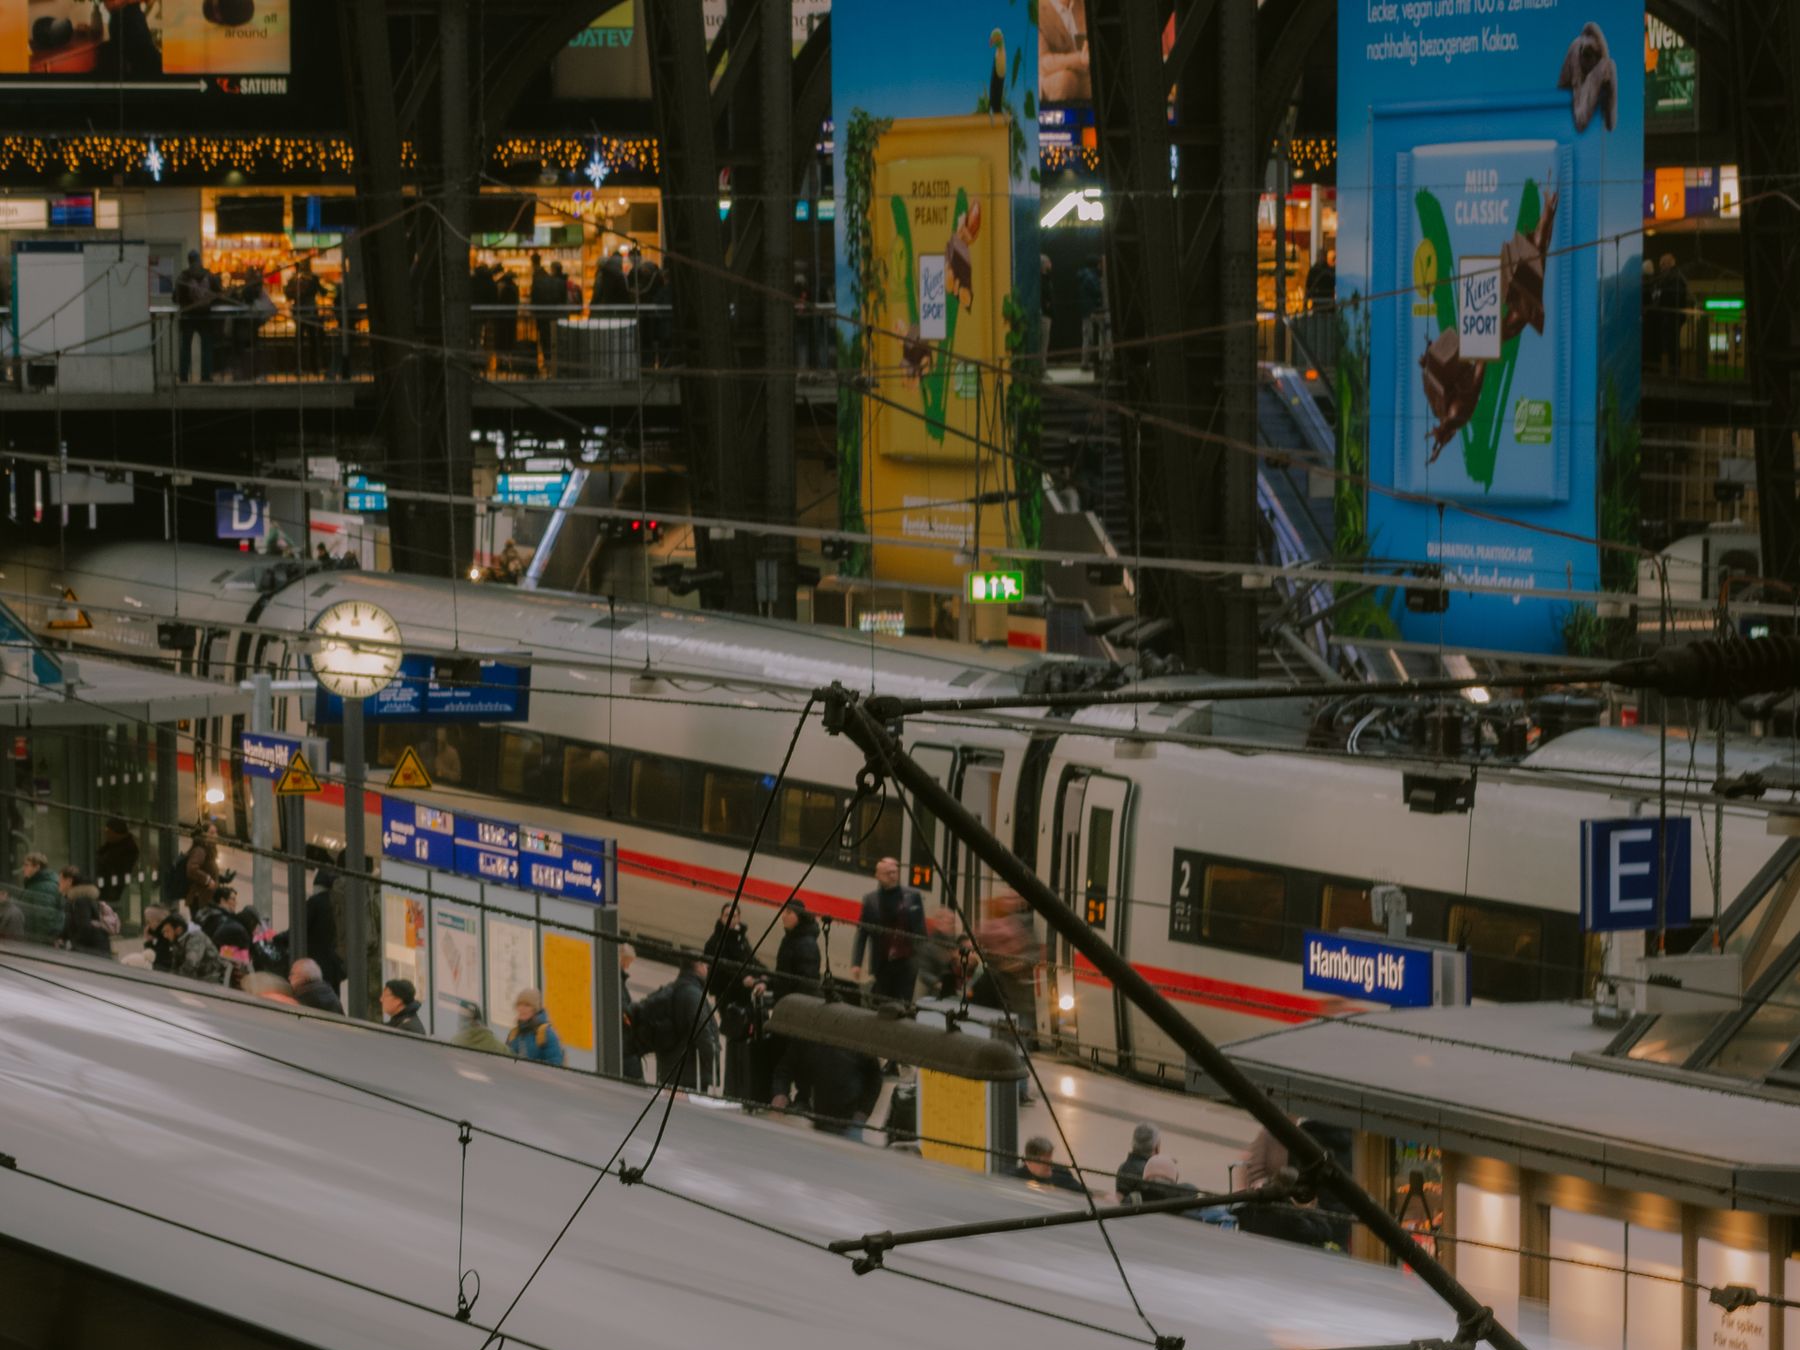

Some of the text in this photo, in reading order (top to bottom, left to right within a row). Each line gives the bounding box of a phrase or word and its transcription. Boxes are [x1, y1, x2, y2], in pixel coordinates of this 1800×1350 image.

[1402, 2, 1433, 28] vegan
[224, 27, 268, 40] around
[1366, 24, 1519, 67] nachhaltig bezogenem Kakao.
[240, 77, 288, 95] SATURN
[911, 179, 950, 198] ROASTED
[1465, 169, 1499, 193] MILD
[914, 206, 948, 226] PEANUT
[1455, 199, 1510, 225] CLASSIC
[1462, 274, 1498, 312] Ritter
[1462, 315, 1498, 335] SPORT
[232, 493, 258, 531] D
[1179, 860, 1191, 898] 2
[1609, 828, 1653, 913] E
[1309, 940, 1405, 993] Hamburg Hbf
